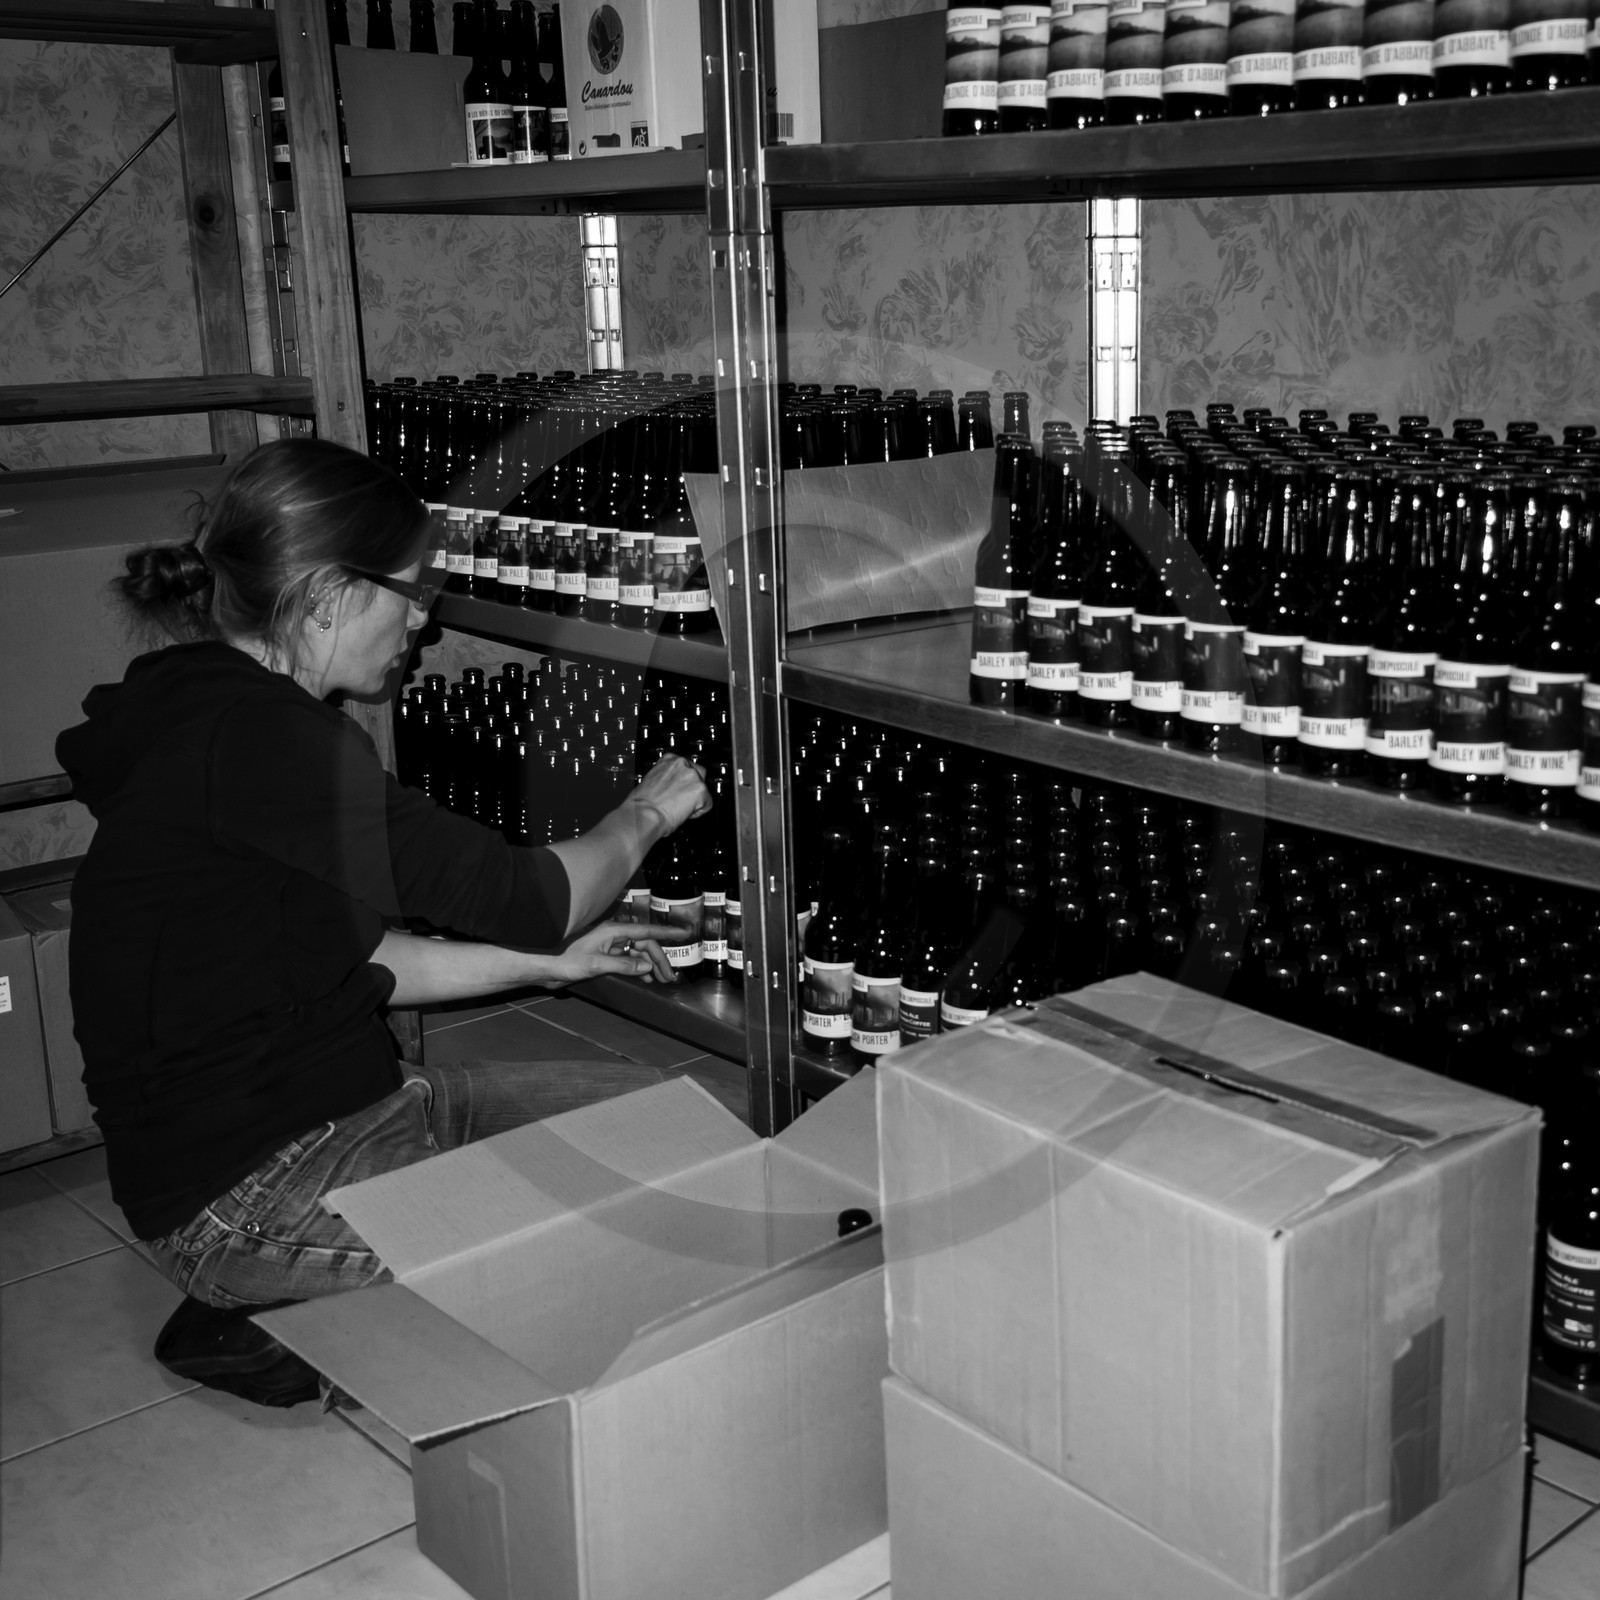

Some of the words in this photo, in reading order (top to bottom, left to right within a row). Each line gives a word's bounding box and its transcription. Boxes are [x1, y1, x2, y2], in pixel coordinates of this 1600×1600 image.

[1449, 34, 1496, 54] D'ABBAYE
[1246, 56, 1289, 73] D'ABBAYE
[1311, 50, 1355, 68] D'ABBAYE
[1059, 72, 1097, 88] D'ABBAYE
[581, 79, 633, 103] Canardou
[457, 557, 472, 566] PALE
[509, 568, 524, 577] PALE
[564, 575, 579, 585] PALE
[591, 581, 603, 590] PALE
[626, 588, 641, 598] PALE
[677, 593, 694, 604] PALE
[696, 592, 706, 603] ALE
[978, 655, 1005, 667] BARLEY
[1009, 655, 1027, 667] WINE
[1030, 666, 1055, 679] BARLEY
[1097, 677, 1117, 689] WINE
[1144, 686, 1162, 698] WINE
[1193, 695, 1212, 708] WINE
[1261, 711, 1282, 724] WINE
[1324, 723, 1347, 737] WINE
[1388, 735, 1423, 749] BARLEY
[1440, 747, 1474, 761] BARLEY
[1479, 747, 1500, 761] WINE
[1540, 755, 1564, 770] WINE
[665, 948, 690, 959] PORTER
[808, 1016, 832, 1028] PORTER
[862, 1033, 888, 1045] PORTER
